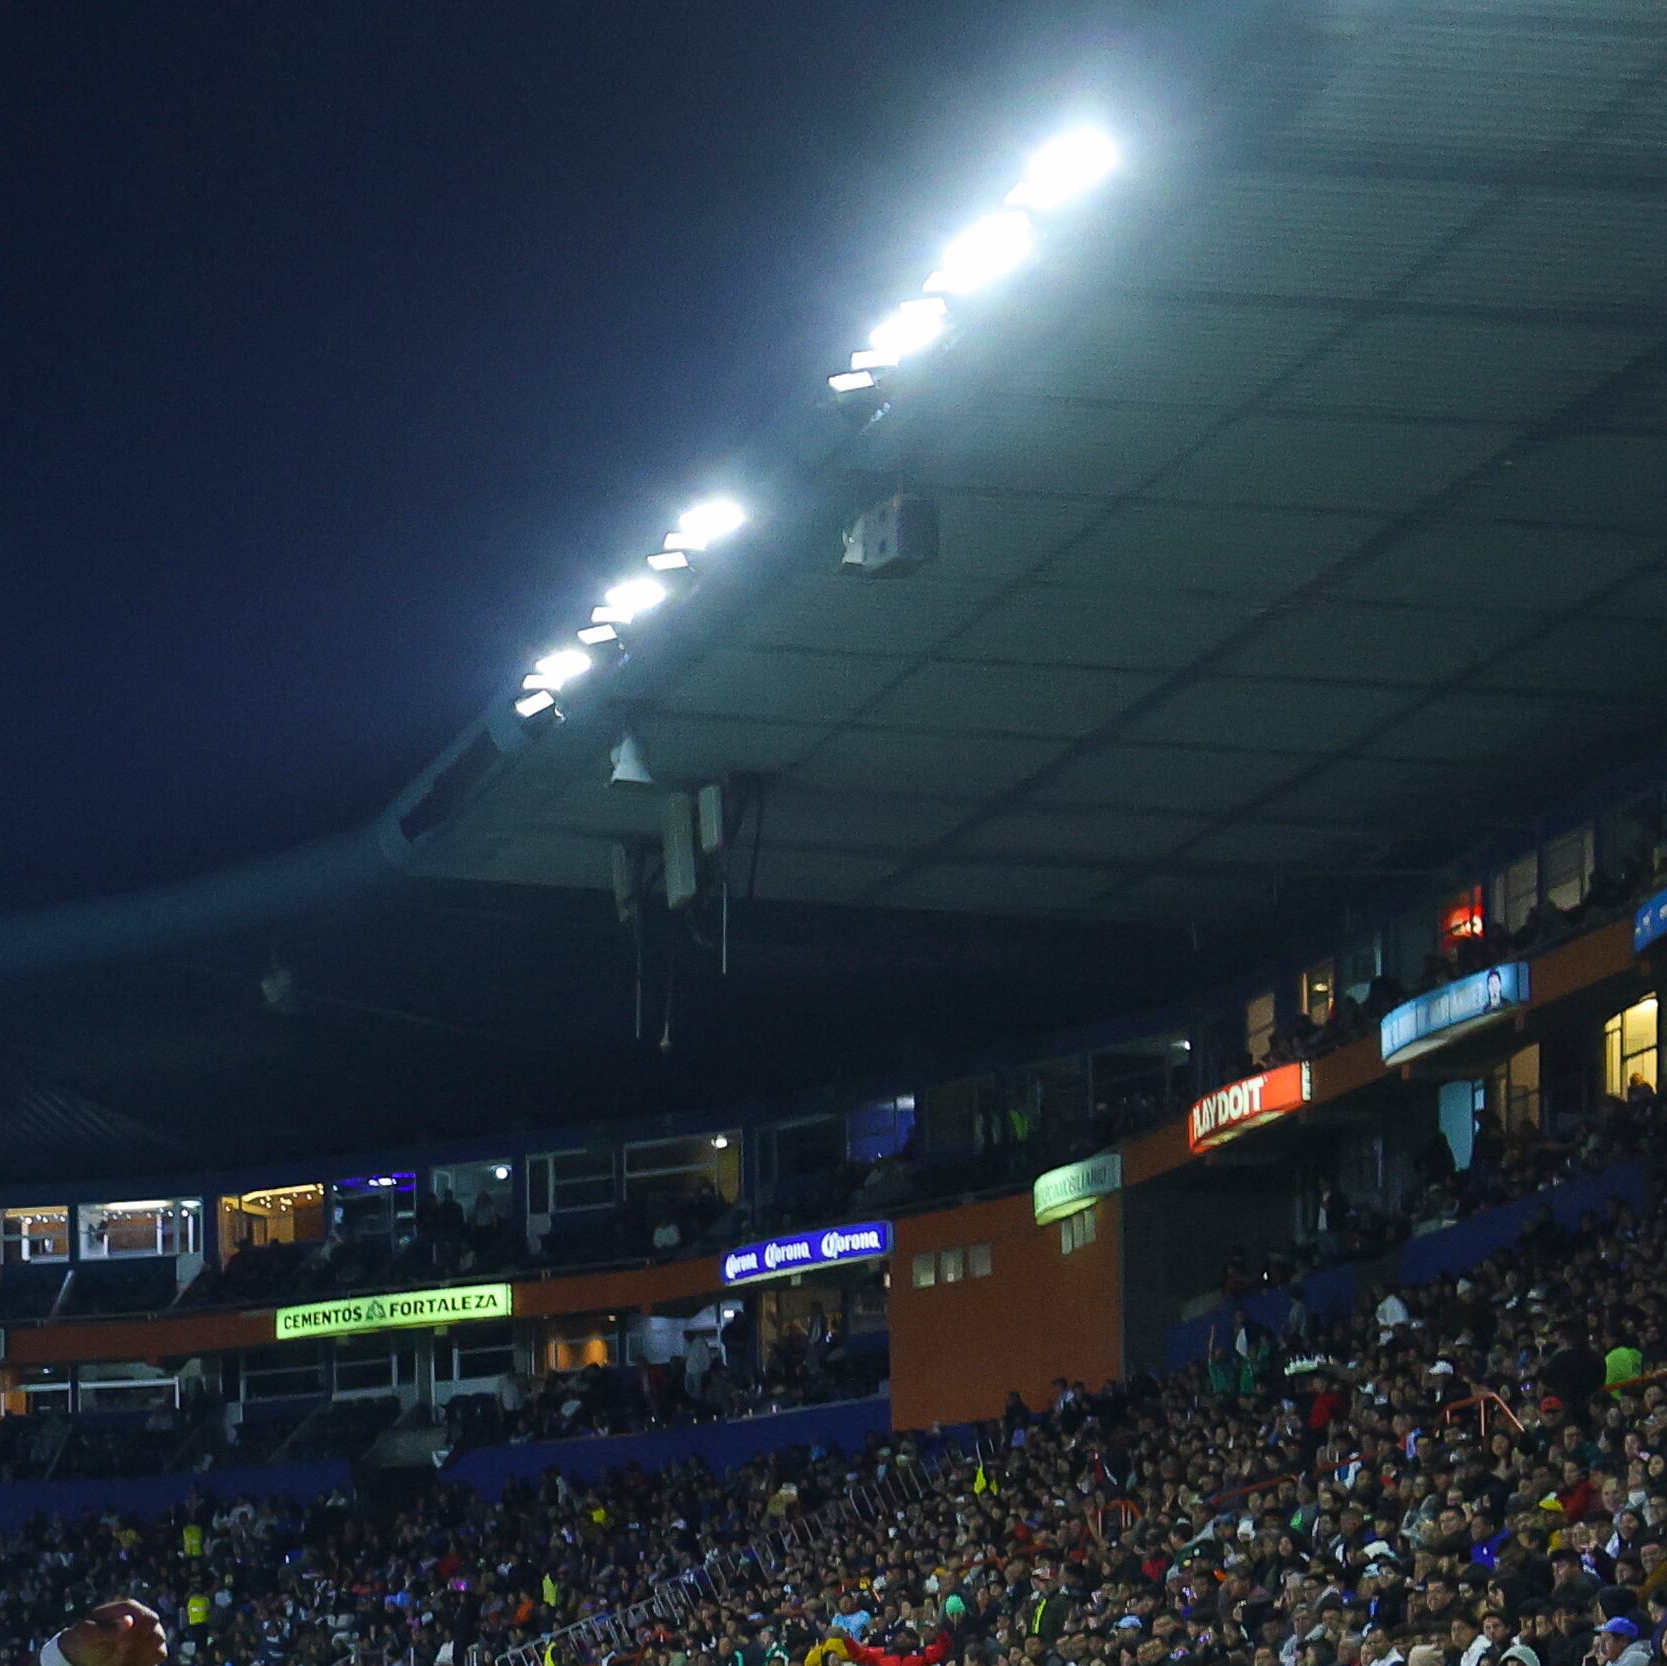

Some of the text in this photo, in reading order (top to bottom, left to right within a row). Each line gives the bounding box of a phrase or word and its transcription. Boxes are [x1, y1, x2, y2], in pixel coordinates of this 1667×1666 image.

[725, 1230, 881, 1279] Corona Corona Corona
[284, 1294, 498, 1330] CEMENTOS FORTALEZA
